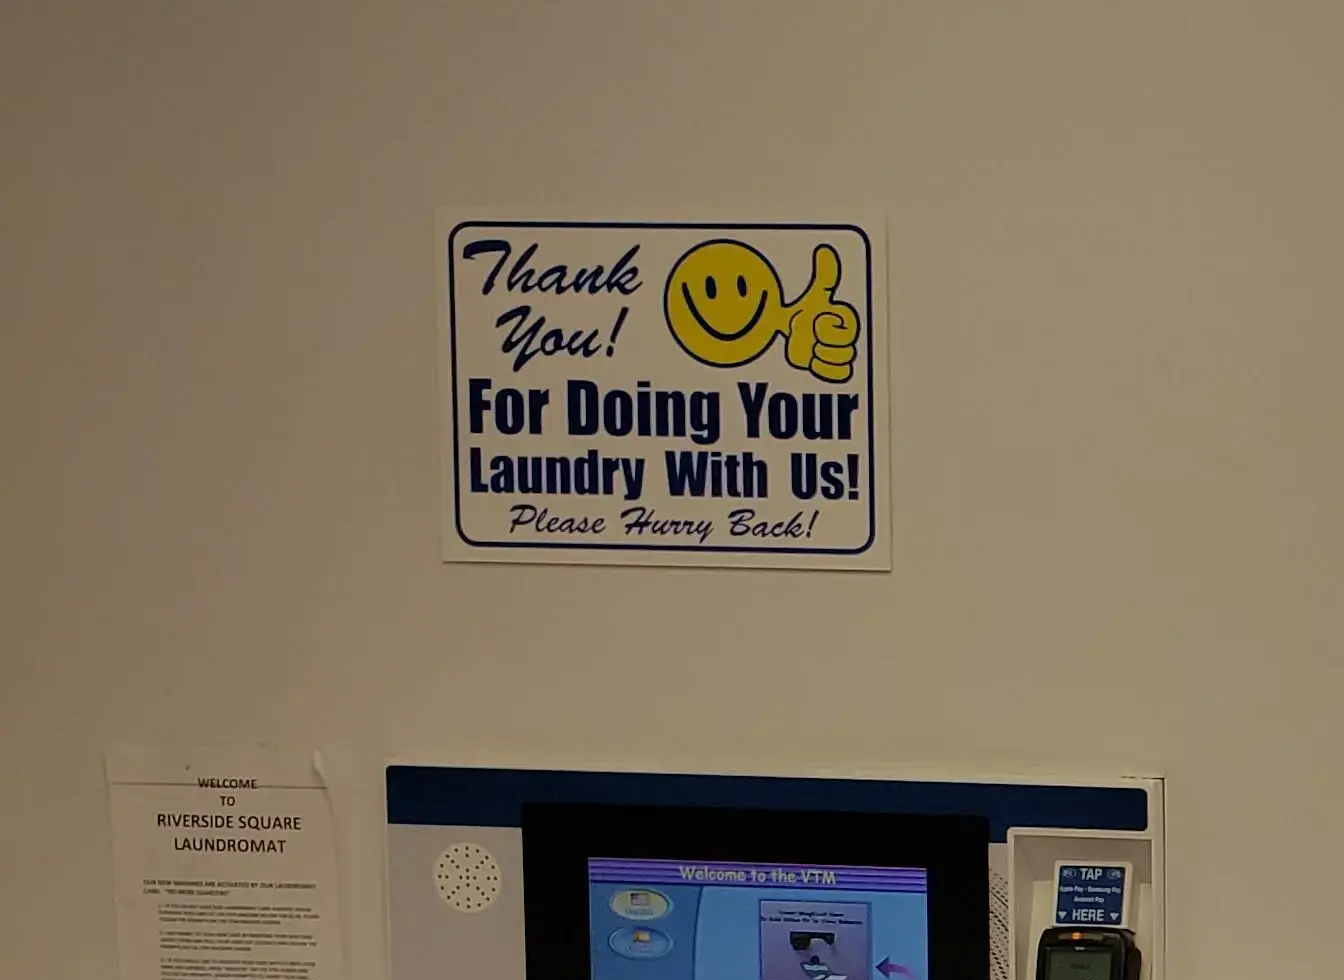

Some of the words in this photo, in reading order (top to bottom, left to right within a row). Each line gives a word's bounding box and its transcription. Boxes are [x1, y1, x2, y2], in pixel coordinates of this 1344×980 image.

[463, 239, 642, 296] Thank
[496, 306, 629, 372] You!
[468, 378, 549, 434] For
[567, 379, 721, 445] Doing
[738, 382, 859, 440] Your
[469, 447, 645, 500] Laundry
[665, 451, 768, 498] With
[790, 453, 860, 500] Us!
[510, 505, 606, 534] Please
[621, 507, 714, 543] Hurry
[728, 509, 819, 539] Back!
[197, 778, 257, 790] WELCOME
[220, 796, 235, 806] TO
[157, 813, 234, 829] RIVERSIDE
[238, 815, 302, 830] SQUARE
[174, 837, 286, 853] LAUNDROMAT
[680, 866, 746, 881] Welcome
[752, 871, 765, 882] to
[771, 871, 796, 883] the
[800, 872, 837, 884] VTM
[1080, 868, 1102, 880] TAP
[1072, 909, 1104, 921] HERE
